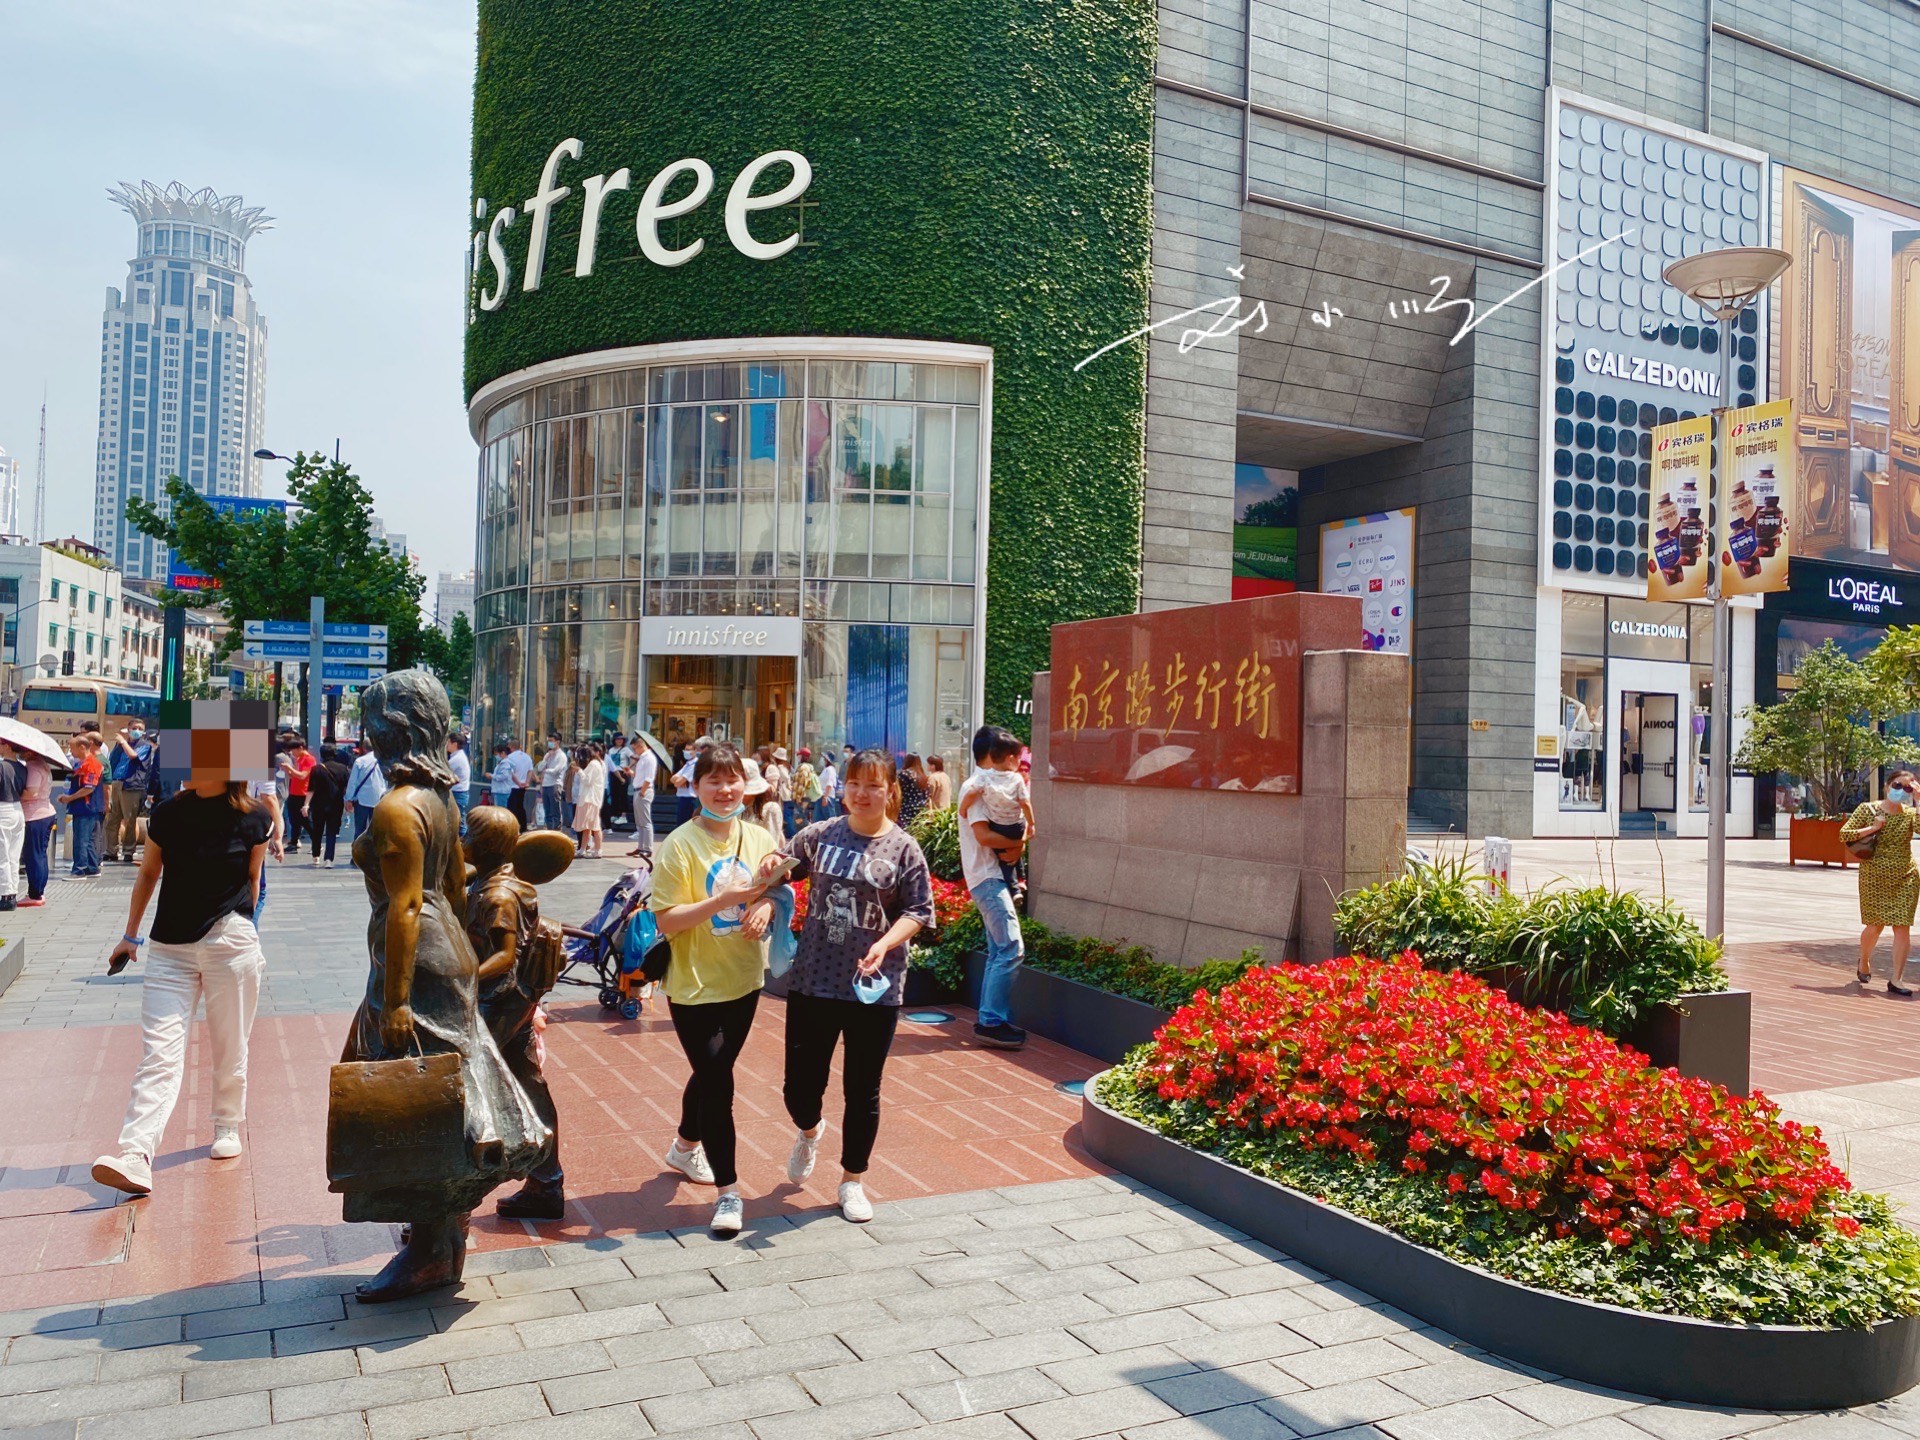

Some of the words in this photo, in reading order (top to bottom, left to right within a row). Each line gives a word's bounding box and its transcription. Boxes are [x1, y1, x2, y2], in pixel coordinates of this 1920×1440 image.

[1746, 417, 1783, 434] 宾格瑞
[1379, 554, 1396, 562] CASIO
[666, 624, 768, 646] innisfree
[1609, 620, 1688, 640] CALZEDONIA
[329, 647, 362, 655] 人民广场
[1062, 650, 1277, 742] 南京路步行街
